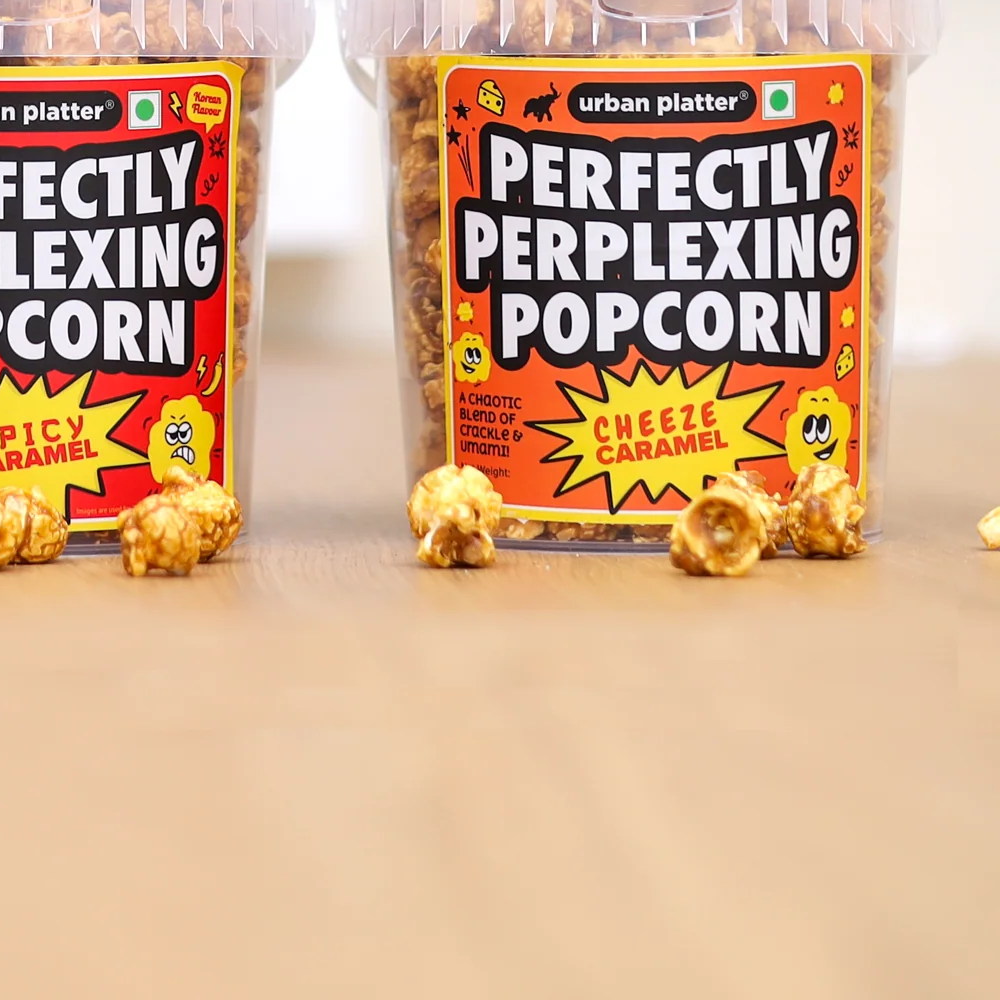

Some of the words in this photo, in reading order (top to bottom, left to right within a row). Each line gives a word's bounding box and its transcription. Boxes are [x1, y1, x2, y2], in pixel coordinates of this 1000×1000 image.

[193, 91, 222, 105] Korean
[579, 92, 650, 112] urban
[192, 103, 222, 117] Flavour
[491, 132, 830, 210] PERFECTLY
[465, 209, 852, 281] PERPLEXING
[502, 291, 821, 358] POPCORN
[459, 391, 466, 404] A
[500, 412, 516, 425] OF
[594, 400, 717, 443] CHEEZE
[513, 430, 523, 442] &
[596, 429, 729, 465] CARAMEL
